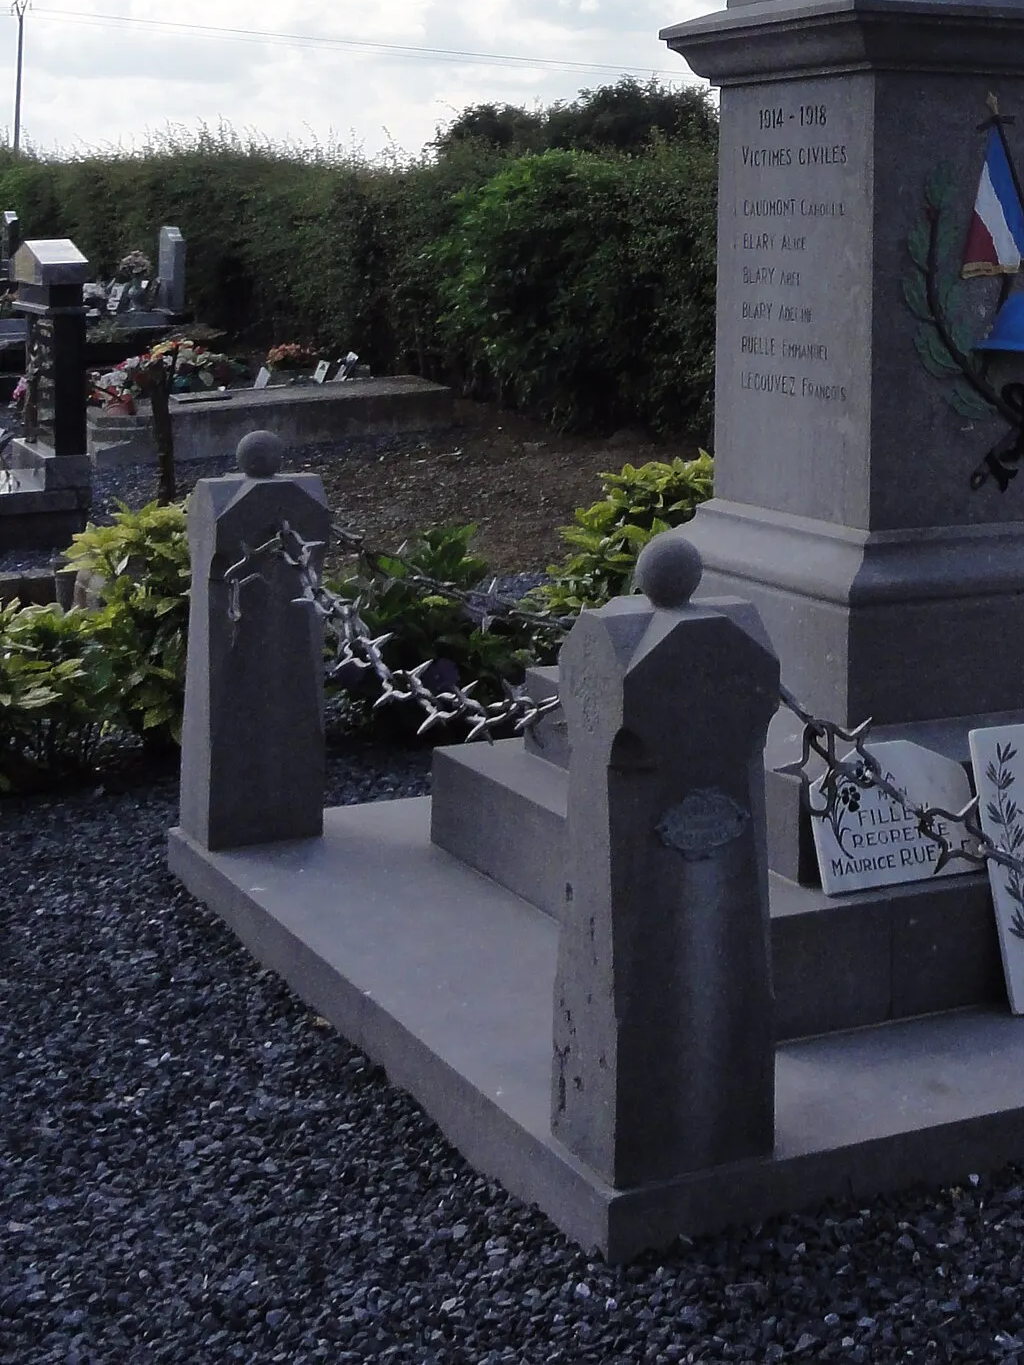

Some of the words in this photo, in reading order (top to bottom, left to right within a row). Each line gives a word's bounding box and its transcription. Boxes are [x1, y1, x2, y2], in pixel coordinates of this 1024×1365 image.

[759, 108, 784, 129] 1914
[800, 105, 827, 127] 1918
[742, 145, 792, 167] VICTIMES
[799, 145, 847, 166] CIVILES
[743, 233, 775, 250] BLARY
[781, 235, 807, 251] ALICE
[743, 266, 776, 285] BLARY
[742, 302, 773, 321] BLARY
[741, 336, 775, 355] RUELLE
[782, 339, 829, 361] EMMANUEL
[885, 772, 895, 783] A
[878, 785, 908, 801] MN
[831, 854, 897, 877] MAURICE
